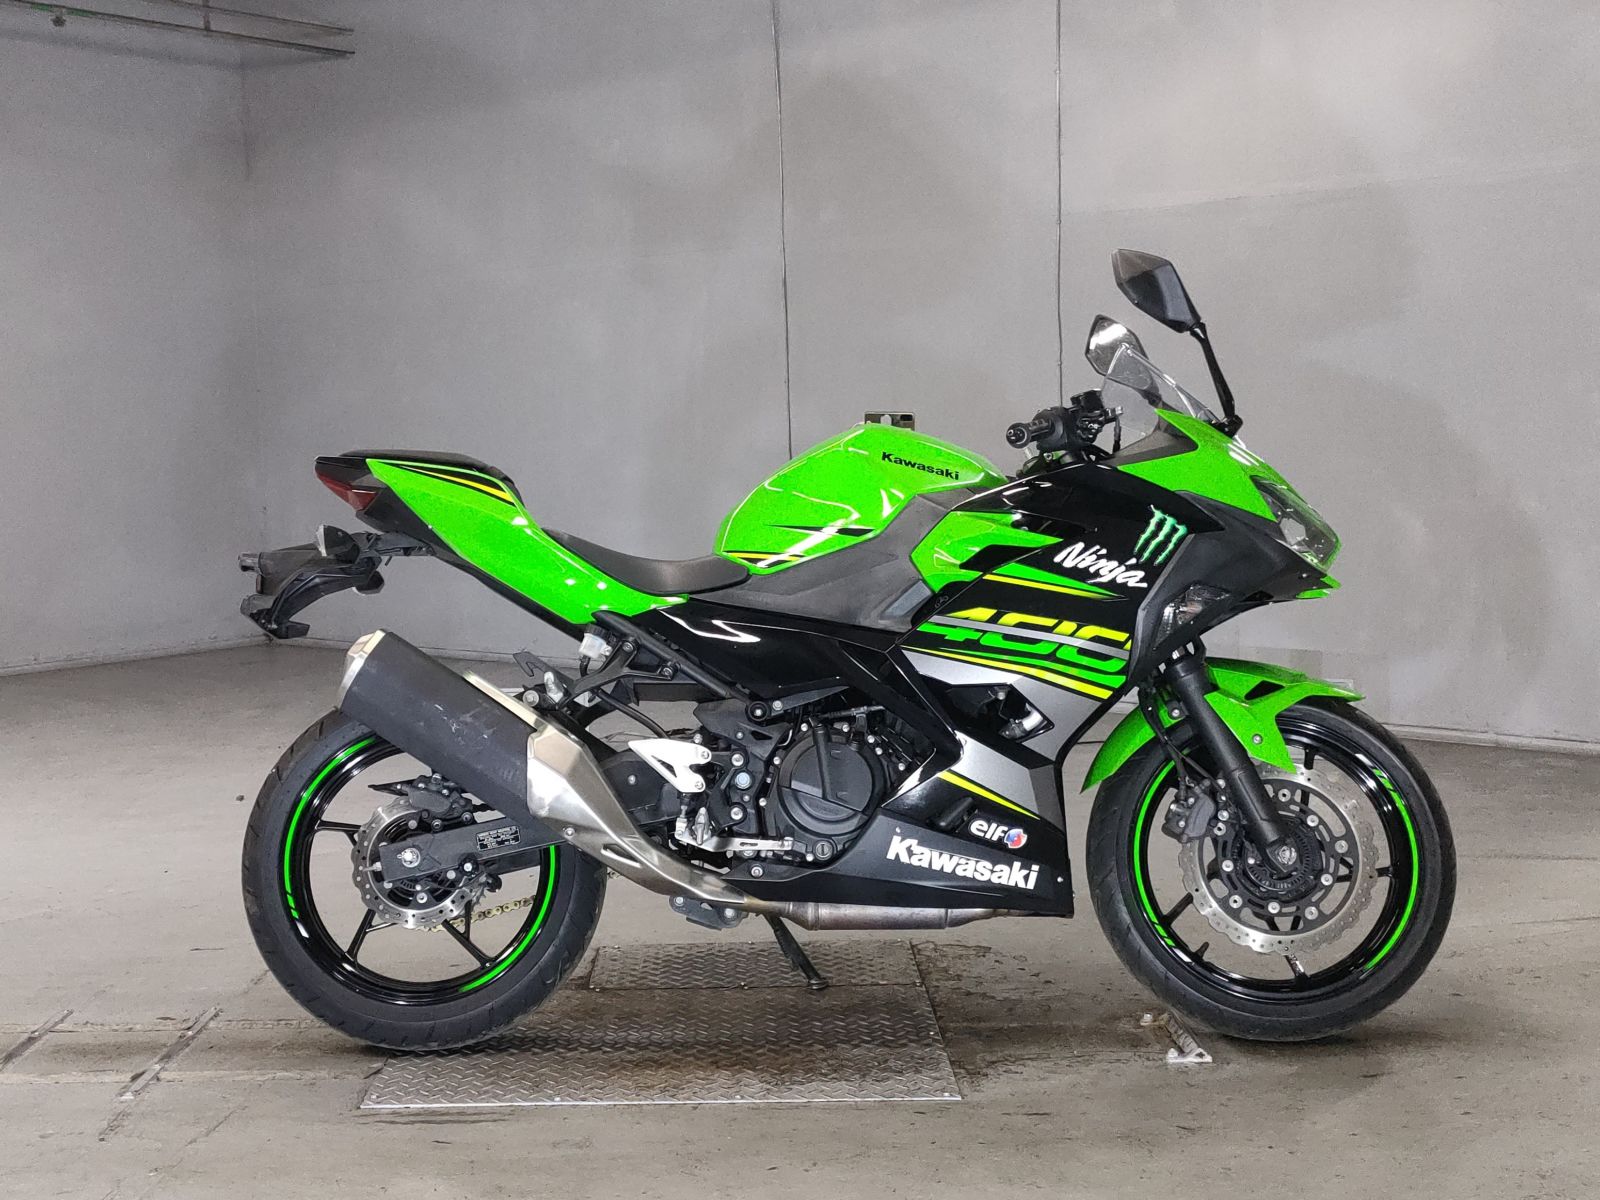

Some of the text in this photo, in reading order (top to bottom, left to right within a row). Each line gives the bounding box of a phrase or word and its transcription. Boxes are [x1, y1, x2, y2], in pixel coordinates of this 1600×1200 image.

[881, 451, 960, 481] Kawasaki
[1052, 541, 1149, 588] Ninja
[916, 606, 1133, 673] 400
[969, 819, 1009, 842] elf
[886, 834, 1040, 890] Kawasaki
